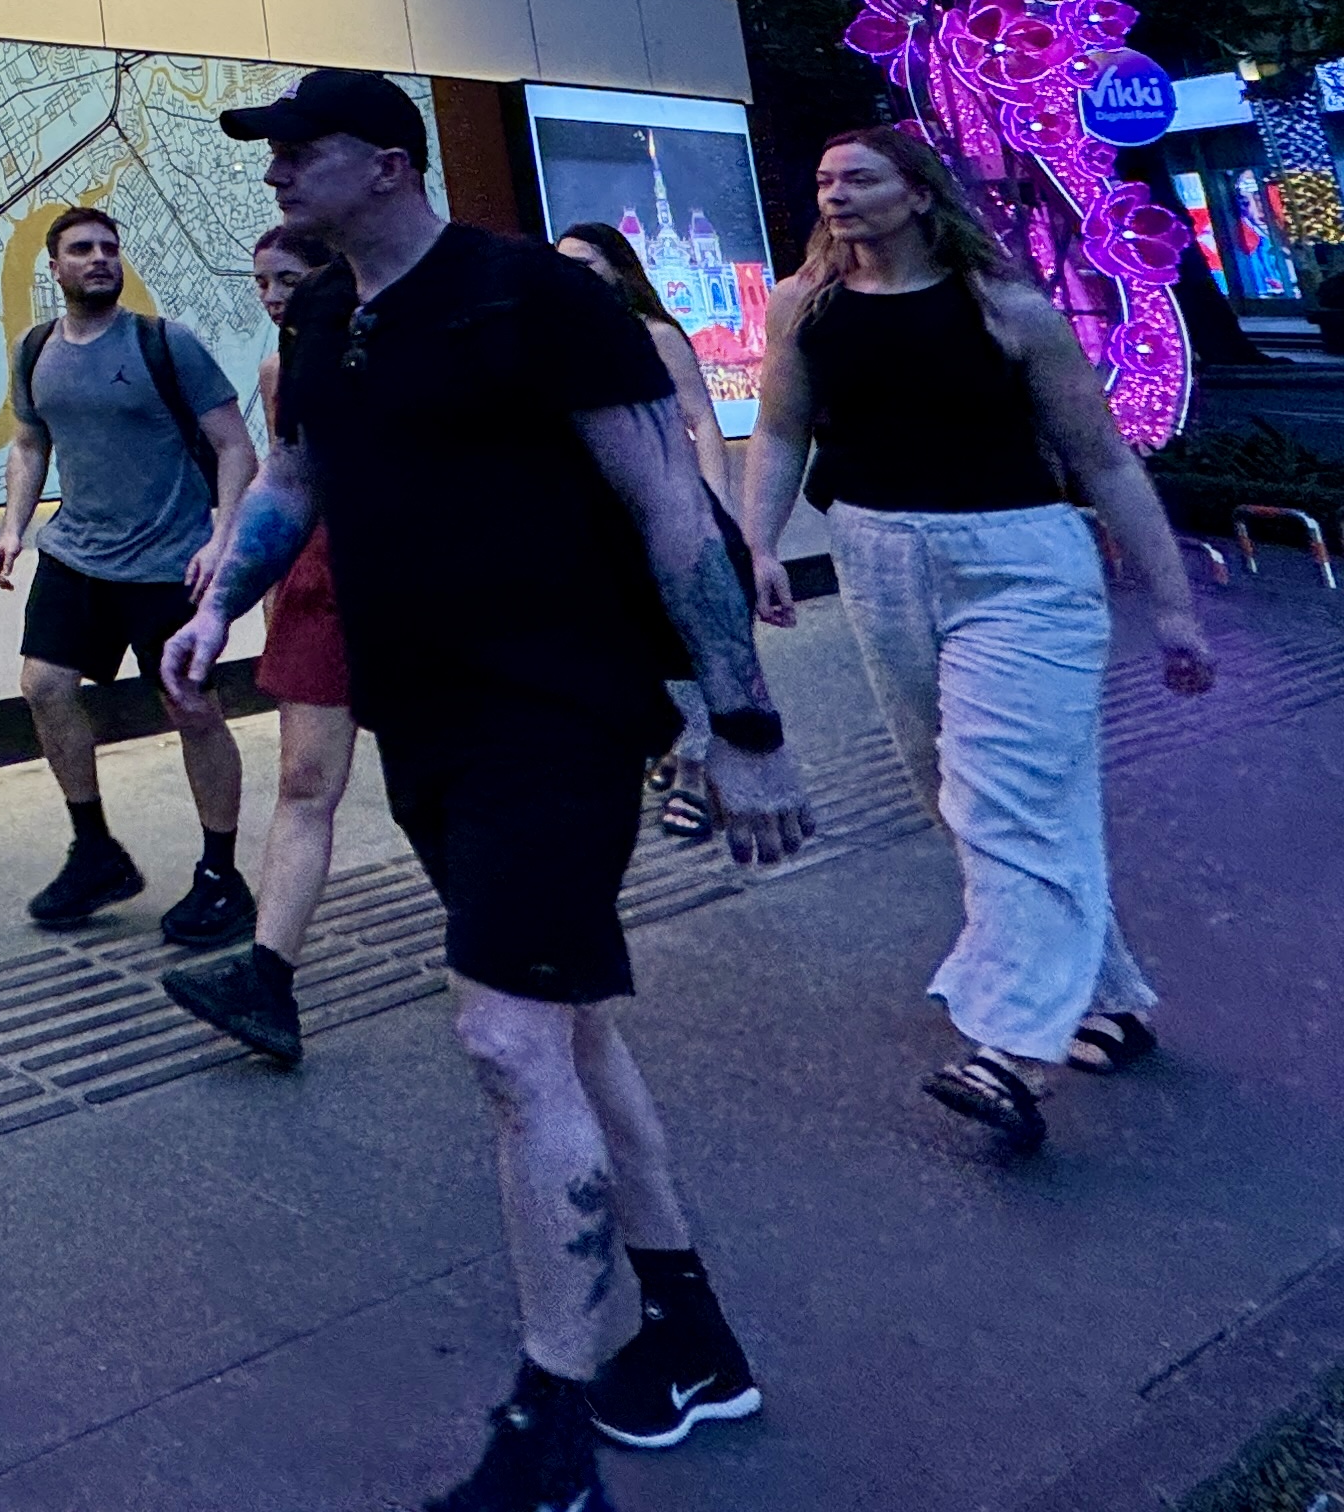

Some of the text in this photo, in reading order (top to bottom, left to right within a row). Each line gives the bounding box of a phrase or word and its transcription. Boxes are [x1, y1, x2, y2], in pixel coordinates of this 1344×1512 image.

[1084, 65, 1163, 107] Vikki
[1095, 110, 1166, 122] Digital Bank
